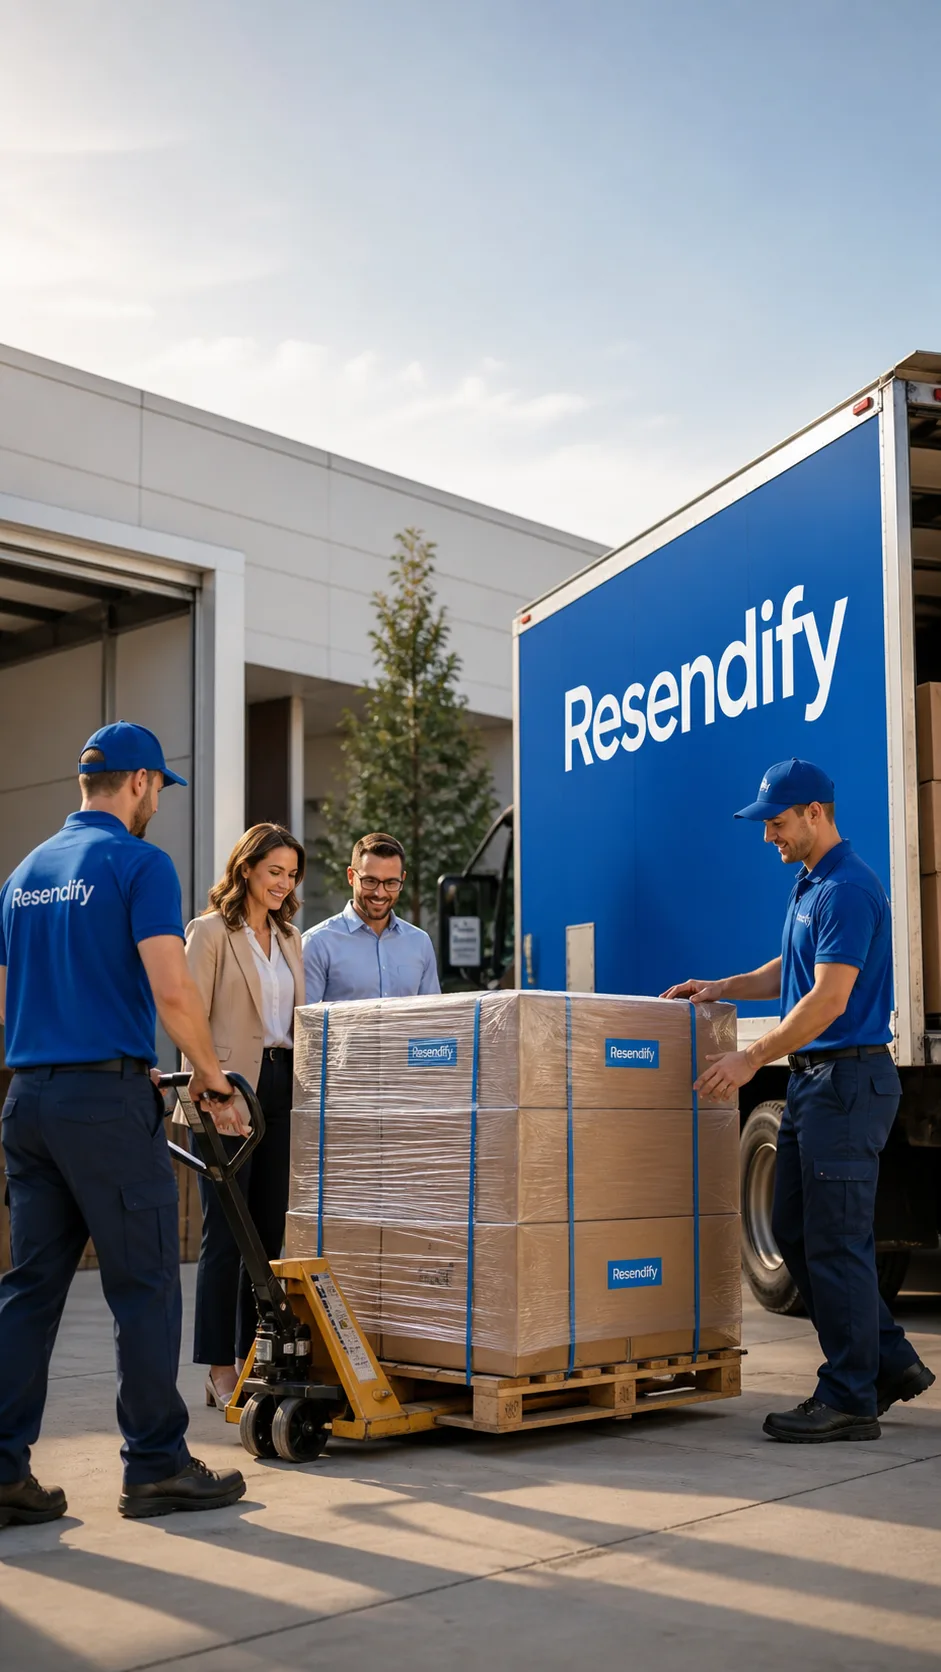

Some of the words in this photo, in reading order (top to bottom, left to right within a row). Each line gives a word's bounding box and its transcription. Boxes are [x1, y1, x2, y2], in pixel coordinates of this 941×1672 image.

[565, 585, 848, 772] Resendify
[11, 879, 95, 909] Resendify
[412, 1045, 454, 1060] Resendify
[610, 1046, 655, 1062] Resendify
[612, 1265, 658, 1280] Resendify
